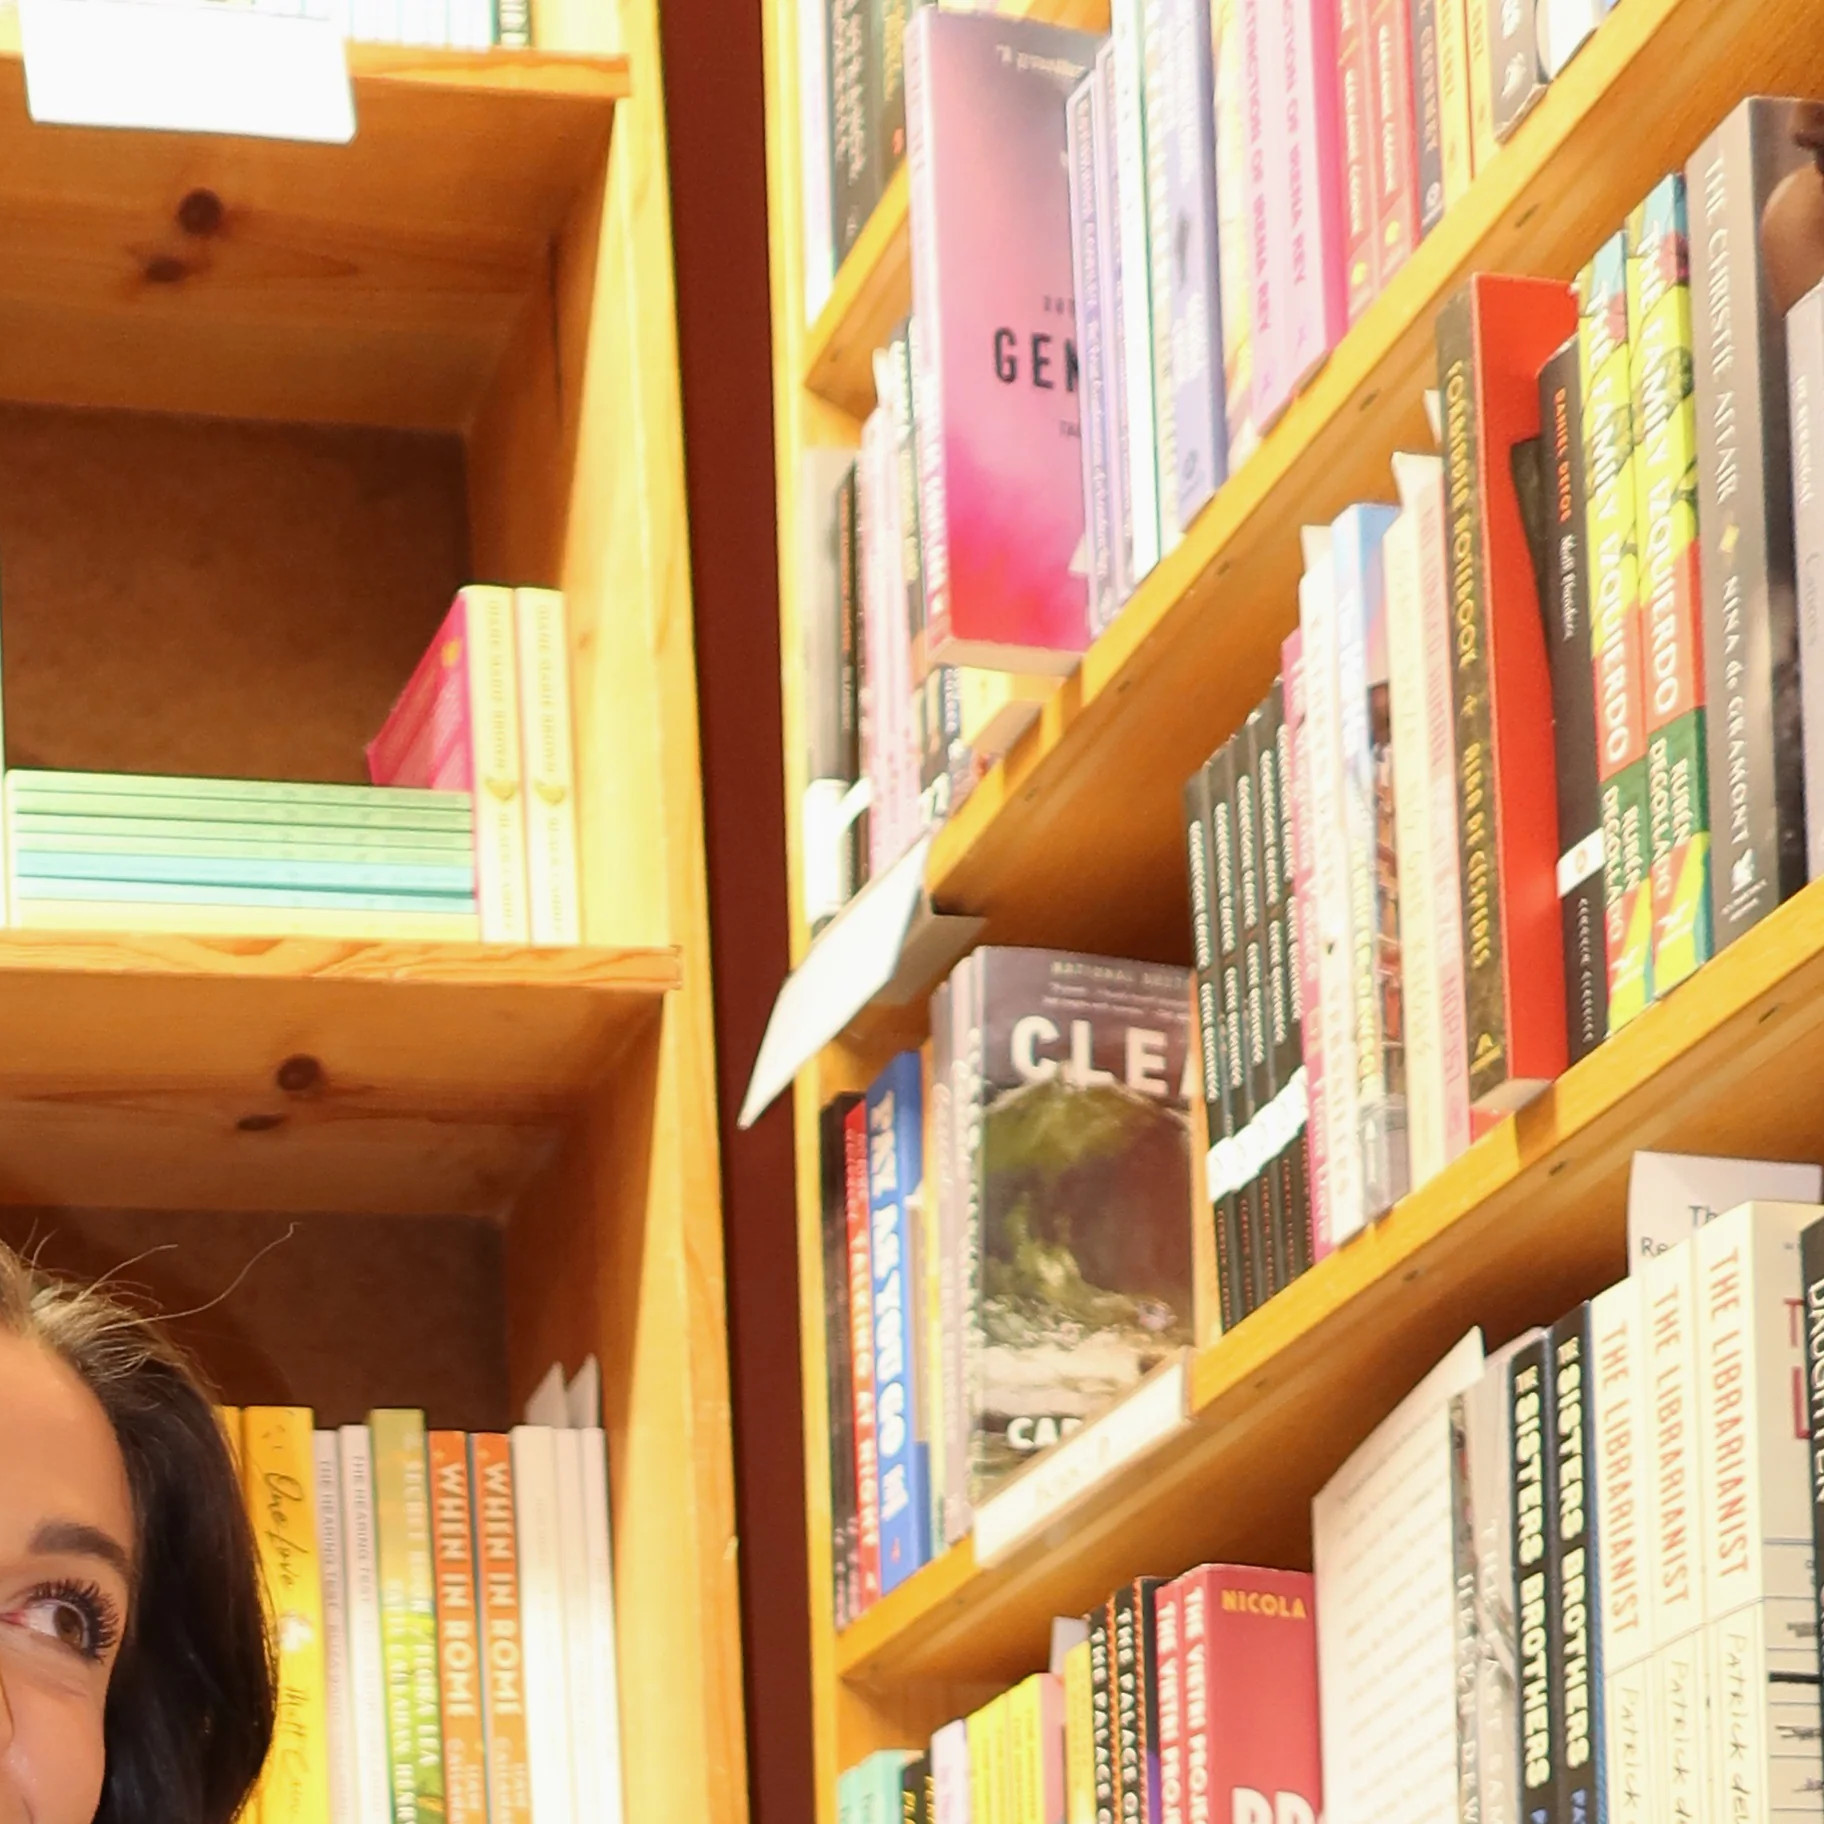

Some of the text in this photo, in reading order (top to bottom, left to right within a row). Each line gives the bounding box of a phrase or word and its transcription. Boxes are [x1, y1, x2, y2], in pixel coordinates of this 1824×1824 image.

[1592, 376, 1619, 516] FAMILY
[1641, 333, 1669, 466] FAMILY
[1722, 577, 1740, 655] NINA
[1516, 1392, 1544, 1565] SISTERS
[1558, 1363, 1584, 1539] SISTERS
[1601, 1320, 1638, 1634] THE LIBRARIANIST
[1654, 1284, 1690, 1605] THE LIBRARIANIST
[1710, 1247, 1748, 1577] THE LIBRARIANIST
[437, 1462, 475, 1715] WHEN IN ROME
[484, 1462, 519, 1714] WHEN IN ROME
[1092, 1627, 1109, 1683] THE
[1116, 1608, 1134, 1666] THE
[1222, 1589, 1307, 1619] NICOLA
[1562, 1547, 1589, 1768] BROTHERS
[1094, 1692, 1112, 1799] PALACE
[1120, 1673, 1138, 1784] PALACE
[1520, 1572, 1550, 1788] BROTHERS
